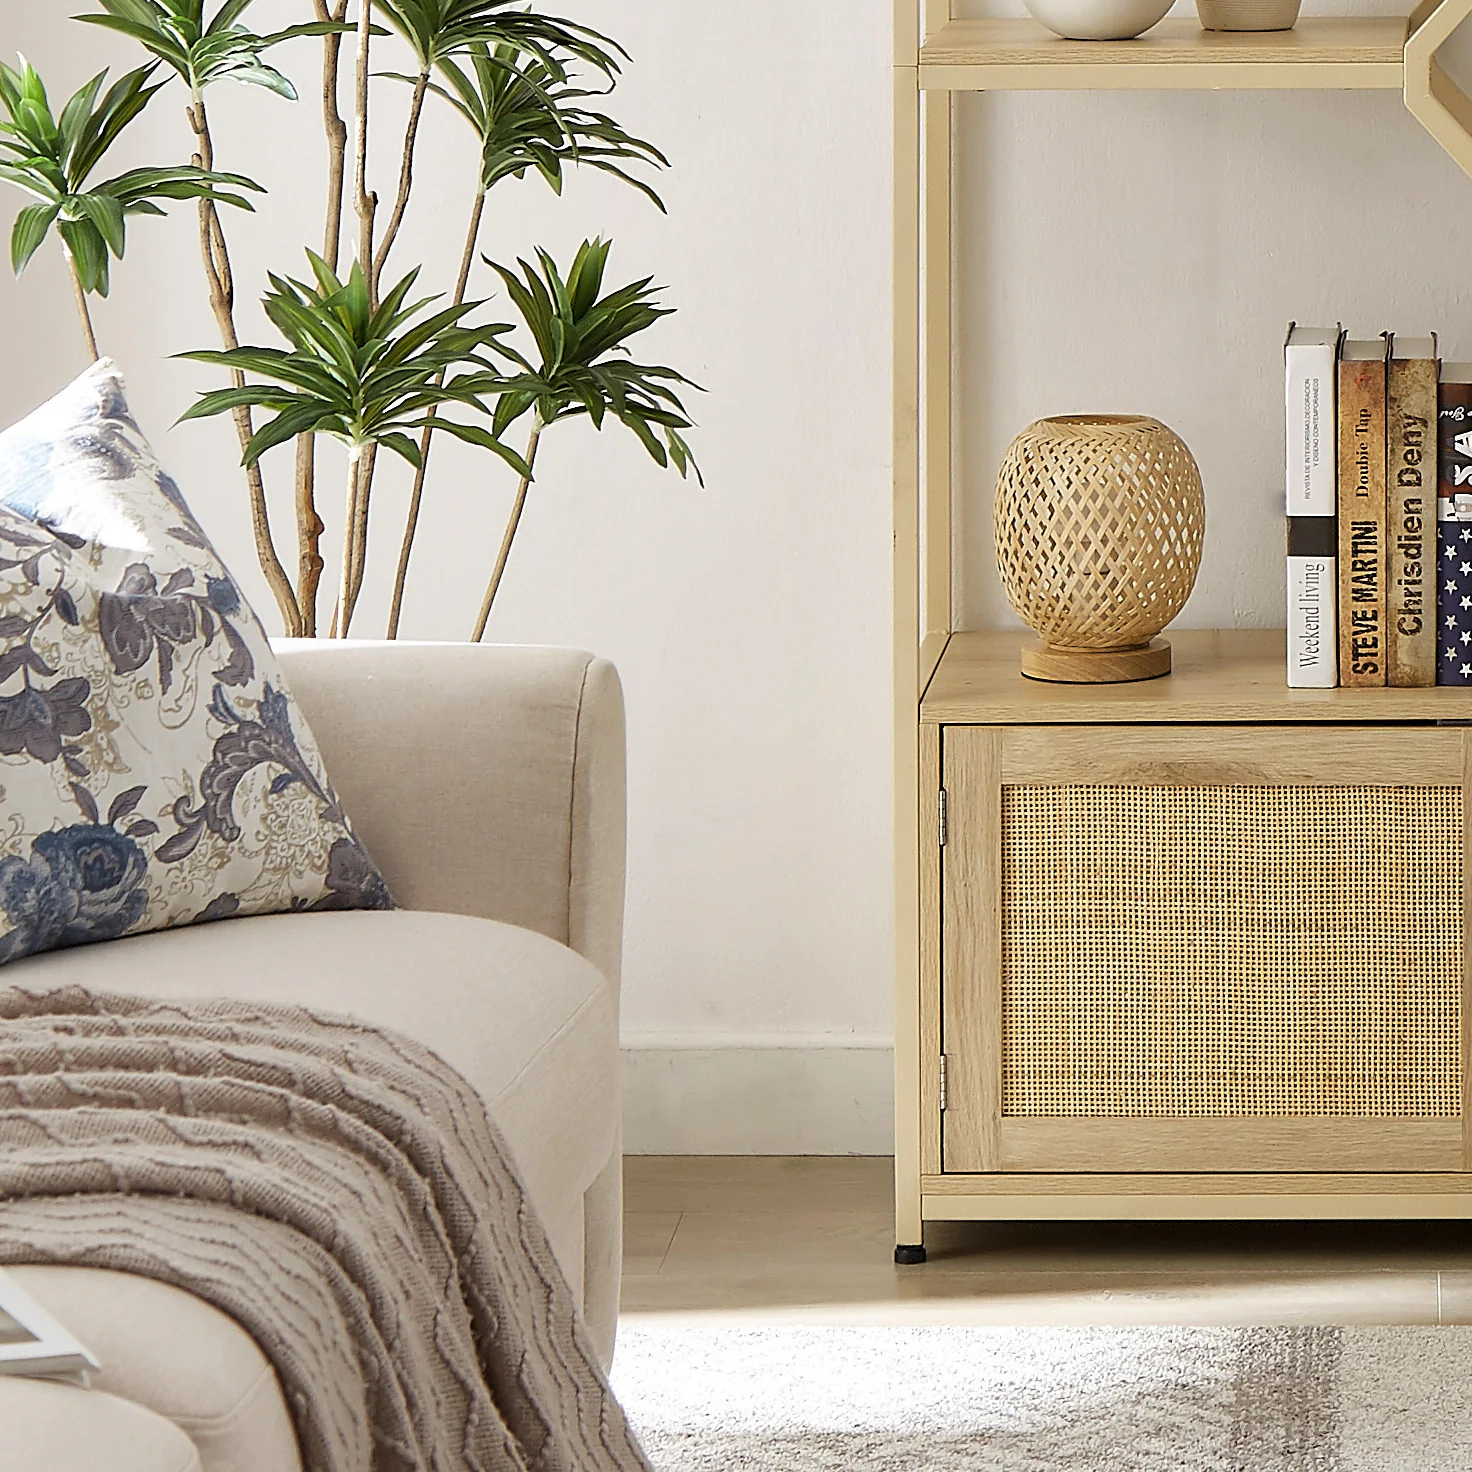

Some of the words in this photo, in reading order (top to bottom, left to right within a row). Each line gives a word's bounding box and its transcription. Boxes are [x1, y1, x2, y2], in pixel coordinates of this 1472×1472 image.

[1355, 408, 1372, 437] Tap
[1397, 412, 1429, 488] Deny
[1298, 563, 1325, 602] living
[1351, 520, 1378, 603] MARTINI
[1299, 607, 1320, 668] Weekend
[1351, 609, 1379, 675] STEVE
